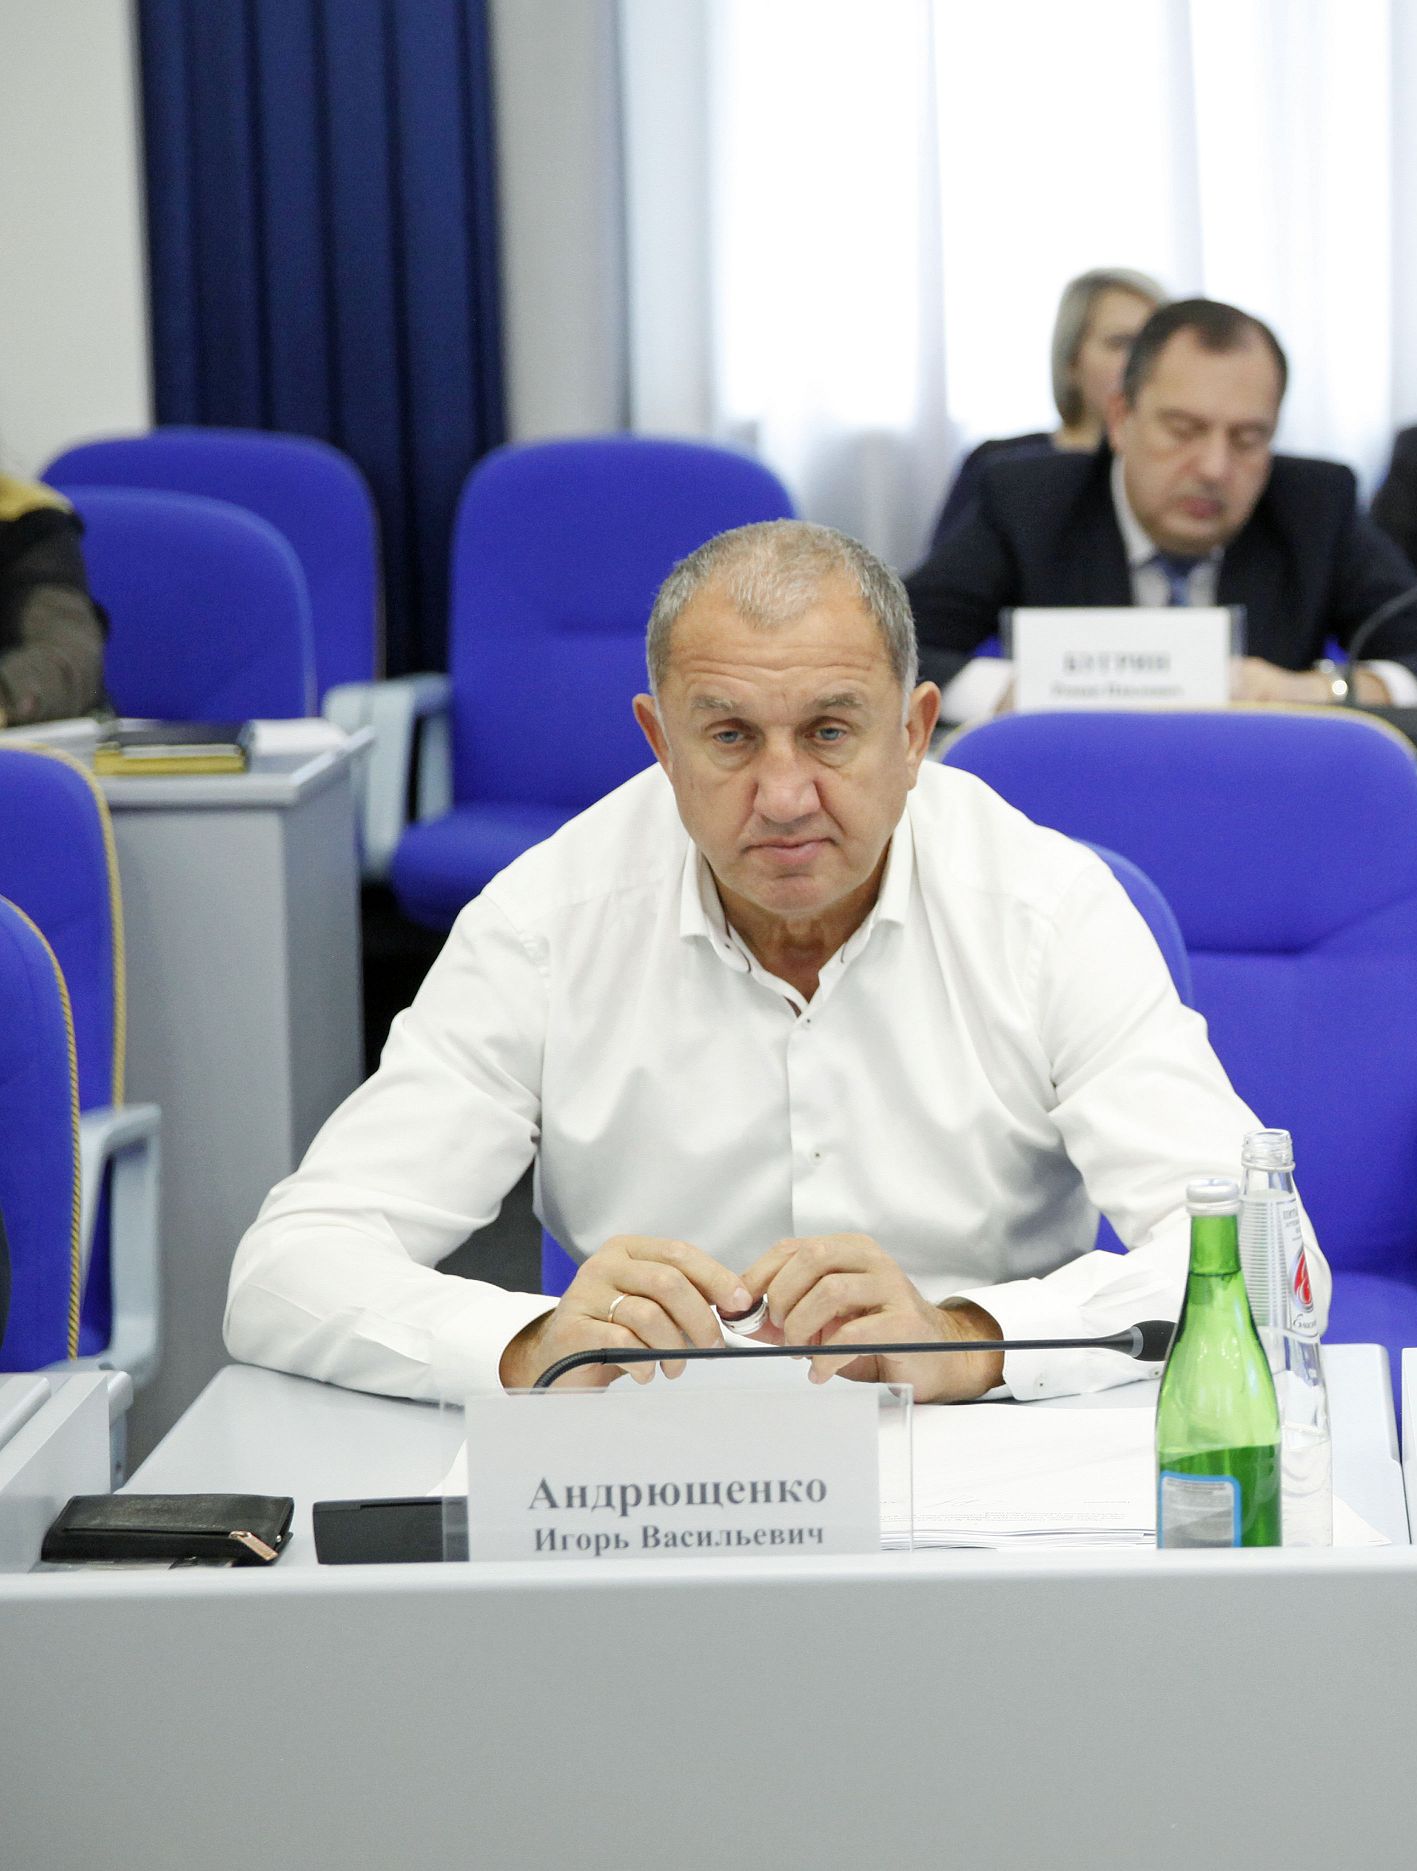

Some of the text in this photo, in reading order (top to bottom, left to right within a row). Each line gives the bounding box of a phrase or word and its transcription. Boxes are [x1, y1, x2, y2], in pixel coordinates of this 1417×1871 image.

[528, 1477, 828, 1518] Андрющенко
[535, 1525, 824, 1558] Игорь Васильевич
